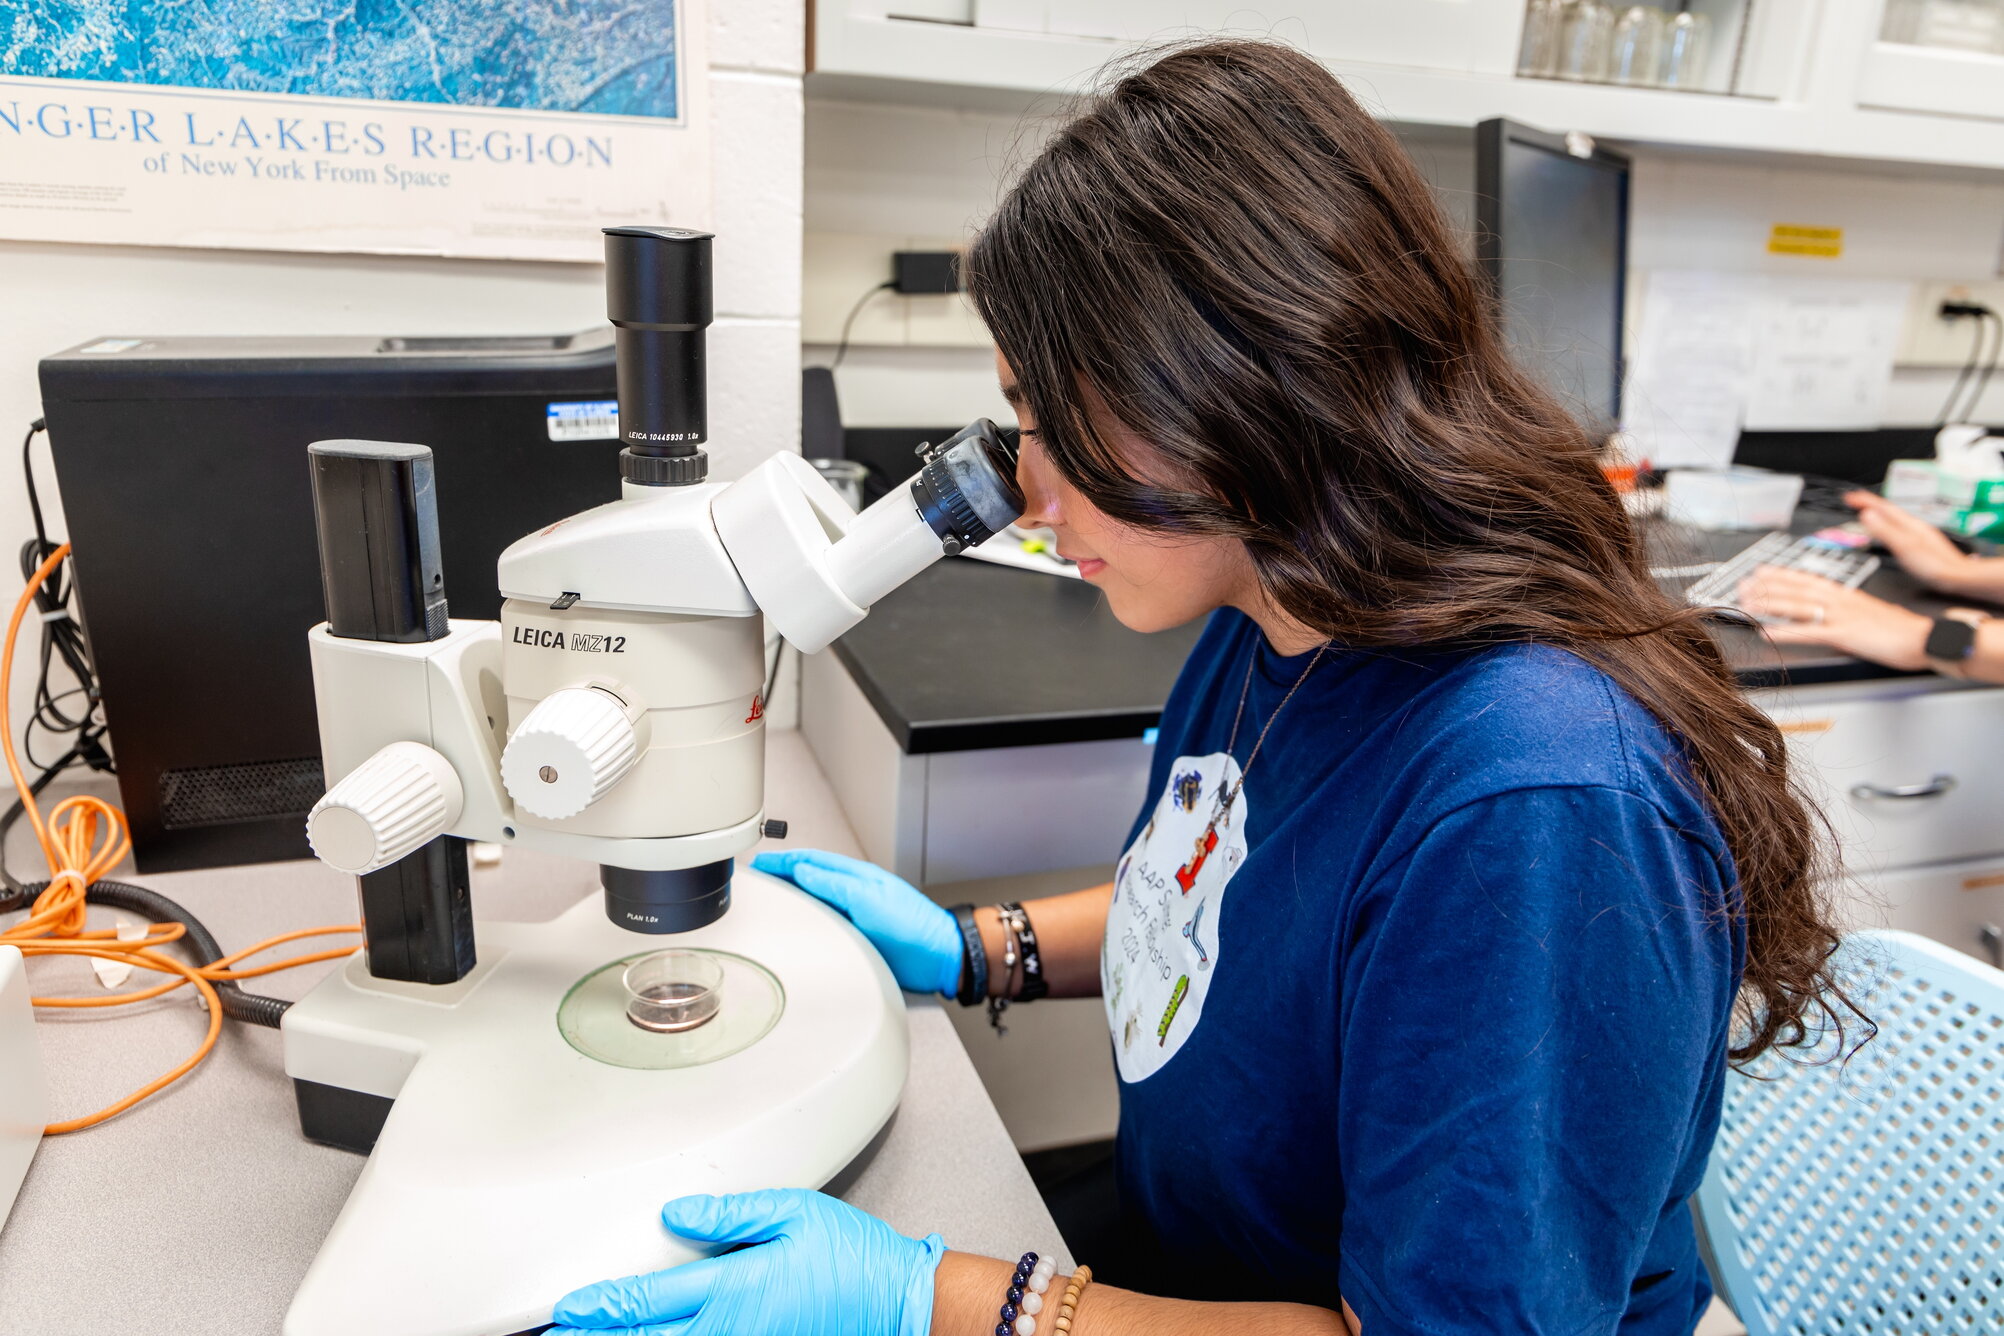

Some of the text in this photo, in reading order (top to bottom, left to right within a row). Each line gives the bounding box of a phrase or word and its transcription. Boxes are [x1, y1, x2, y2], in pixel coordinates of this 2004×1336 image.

[143, 152, 451, 191] of New York From Space
[628, 431, 648, 440] LEICA
[649, 433, 684, 441] 10445930
[512, 626, 627, 653] LEICA MZ12
[1138, 861, 1165, 891] AAP
[626, 912, 644, 922] PLAN
[1125, 868, 1150, 924] arch
[1144, 917, 1171, 981] Foship
